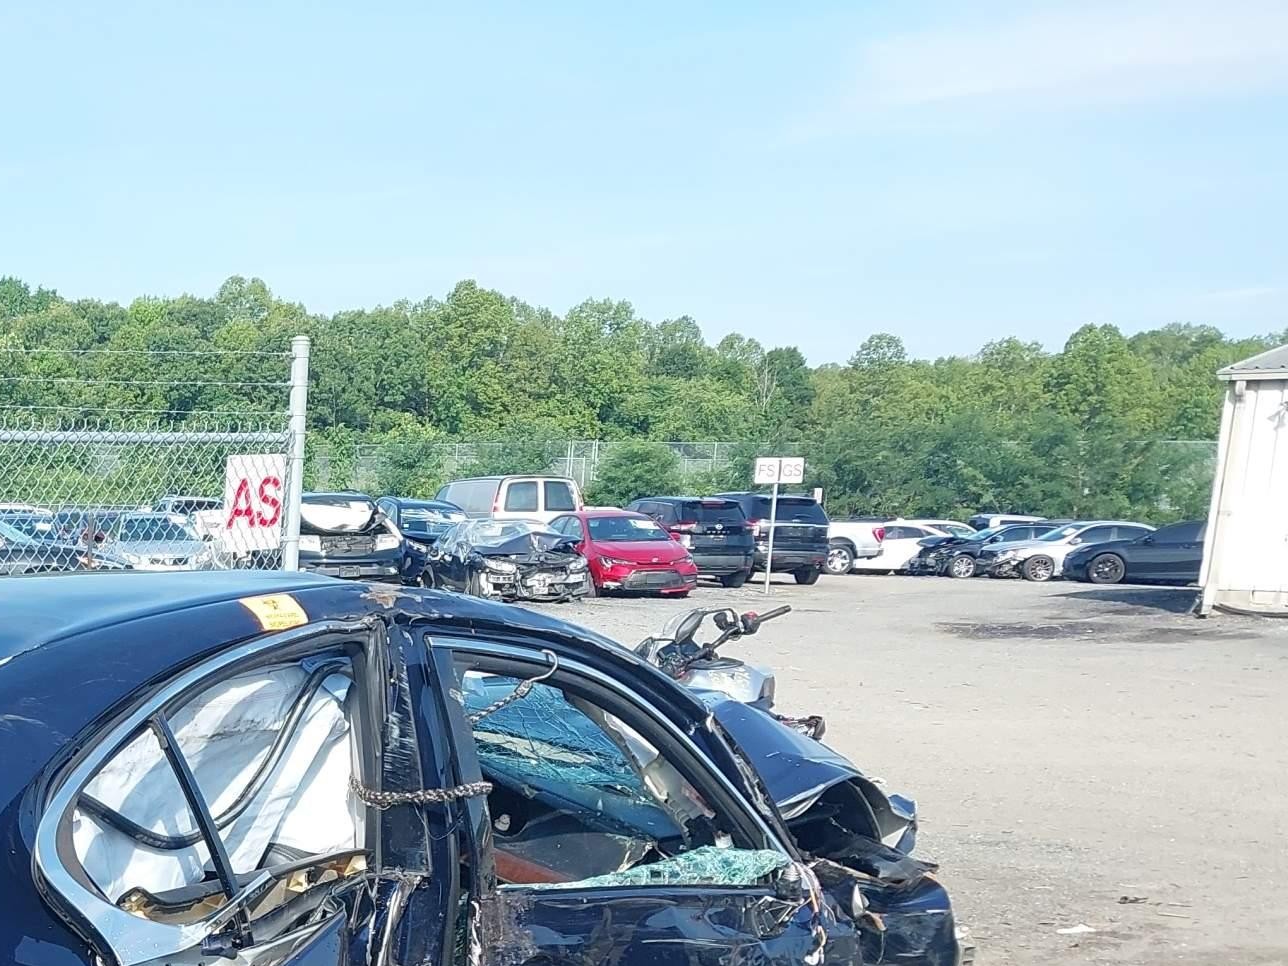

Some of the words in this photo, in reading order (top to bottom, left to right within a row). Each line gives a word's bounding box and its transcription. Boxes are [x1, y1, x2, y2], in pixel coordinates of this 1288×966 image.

[758, 463, 776, 478] FS
[782, 463, 803, 477] GS
[226, 475, 282, 529] AS
